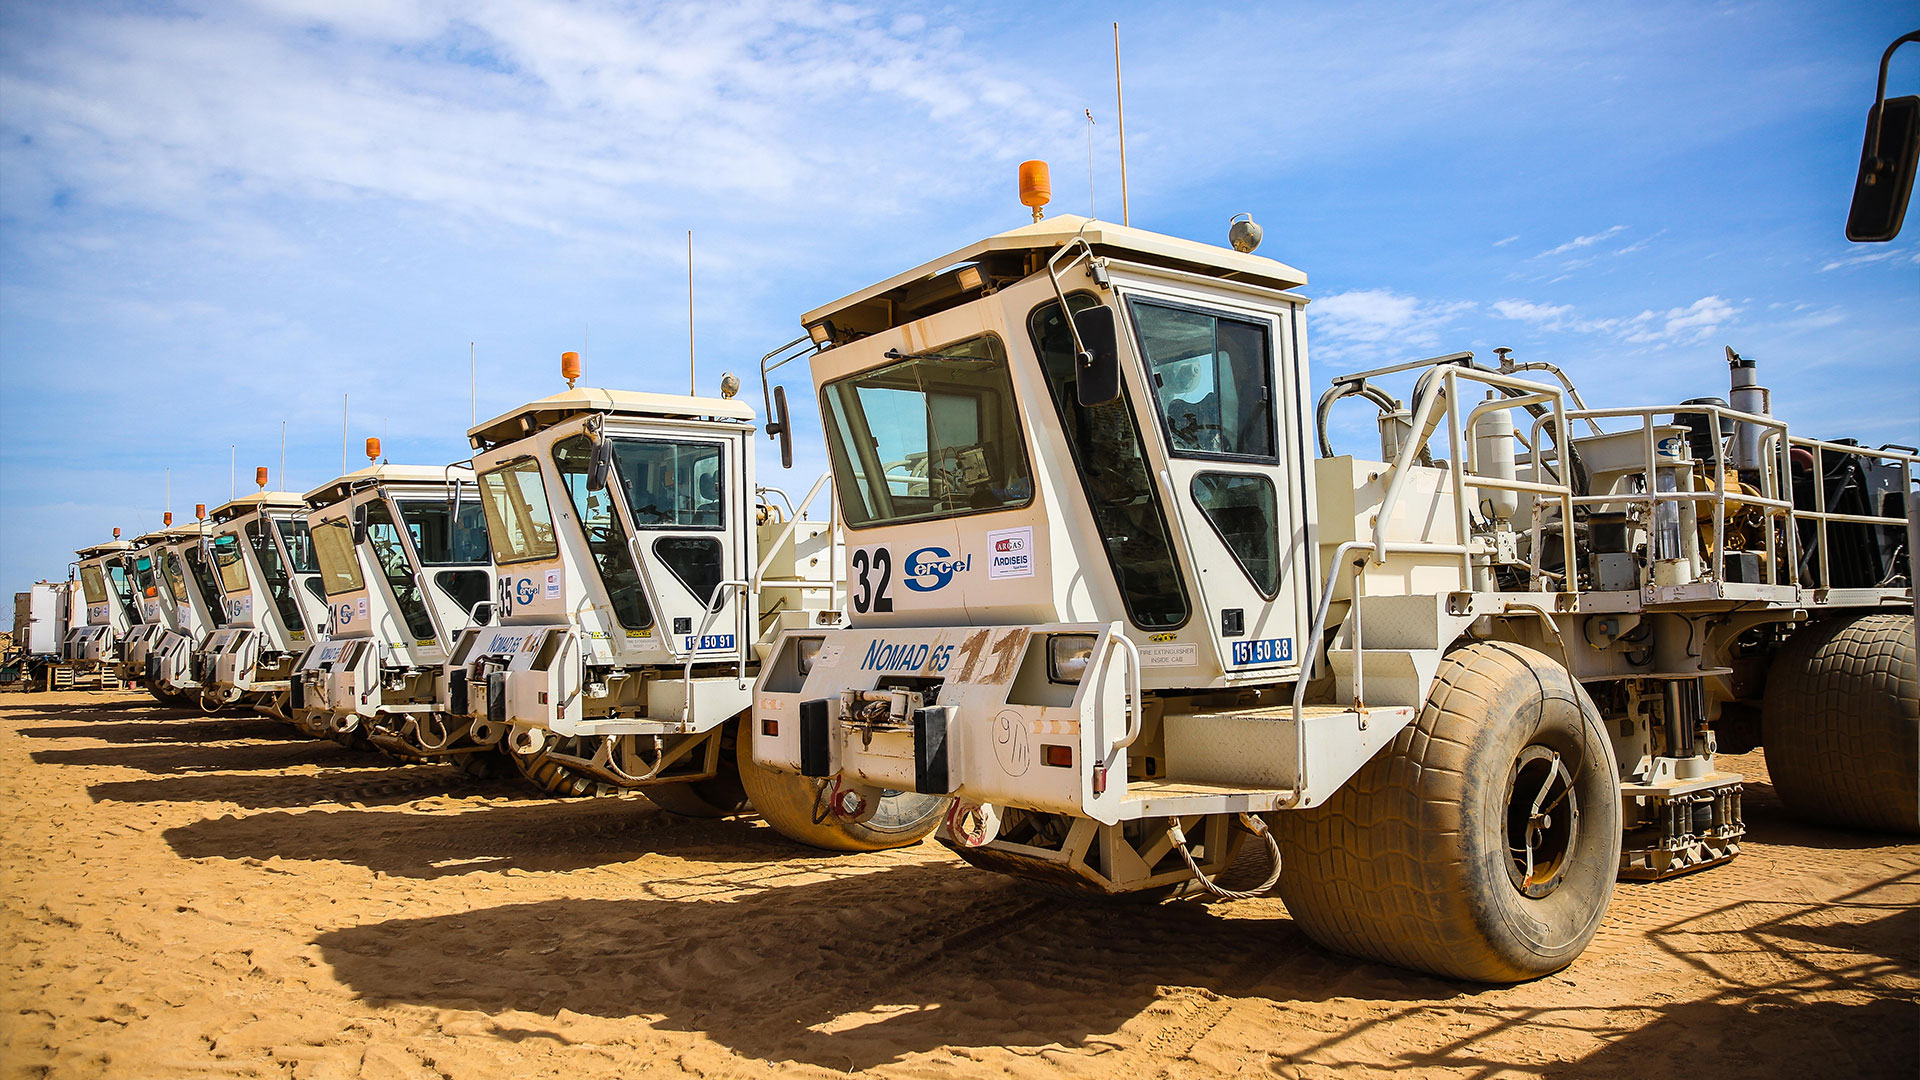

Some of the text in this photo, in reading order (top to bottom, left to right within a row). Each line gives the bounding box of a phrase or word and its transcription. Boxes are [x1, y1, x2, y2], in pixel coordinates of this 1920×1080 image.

[904, 547, 972, 592] Sercel
[994, 555, 1028, 567] ARDISEIS
[853, 547, 893, 613] 32
[498, 577, 513, 618] 35
[705, 636, 716, 648] 50
[720, 635, 730, 648] 91
[1154, 647, 1194, 656] EXTINGUISHER
[1234, 639, 1290, 662] 151 50 88
[860, 638, 929, 671] NOMAD
[928, 645, 955, 672] 65
[1151, 656, 1170, 664] INSIDE
